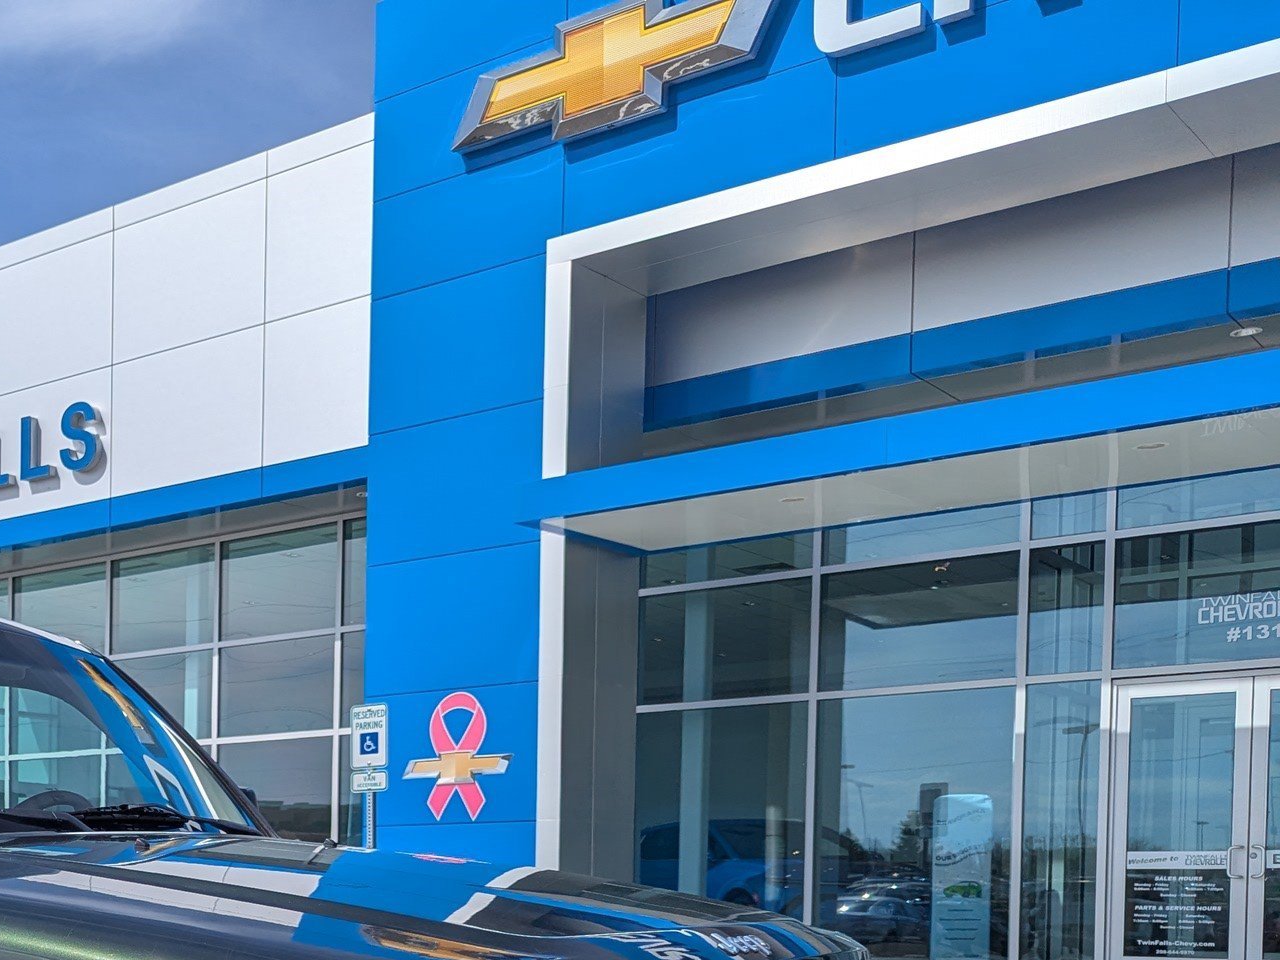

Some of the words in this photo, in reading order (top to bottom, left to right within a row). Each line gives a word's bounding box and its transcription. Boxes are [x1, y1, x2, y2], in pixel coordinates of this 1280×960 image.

[353, 709, 385, 721] RESERVED
[355, 720, 383, 731] PARKING
[1128, 857, 1168, 865] Welcome
[710, 932, 772, 956] Jeep
[1136, 939, 1216, 948] TwinFalls-Chevy.com
